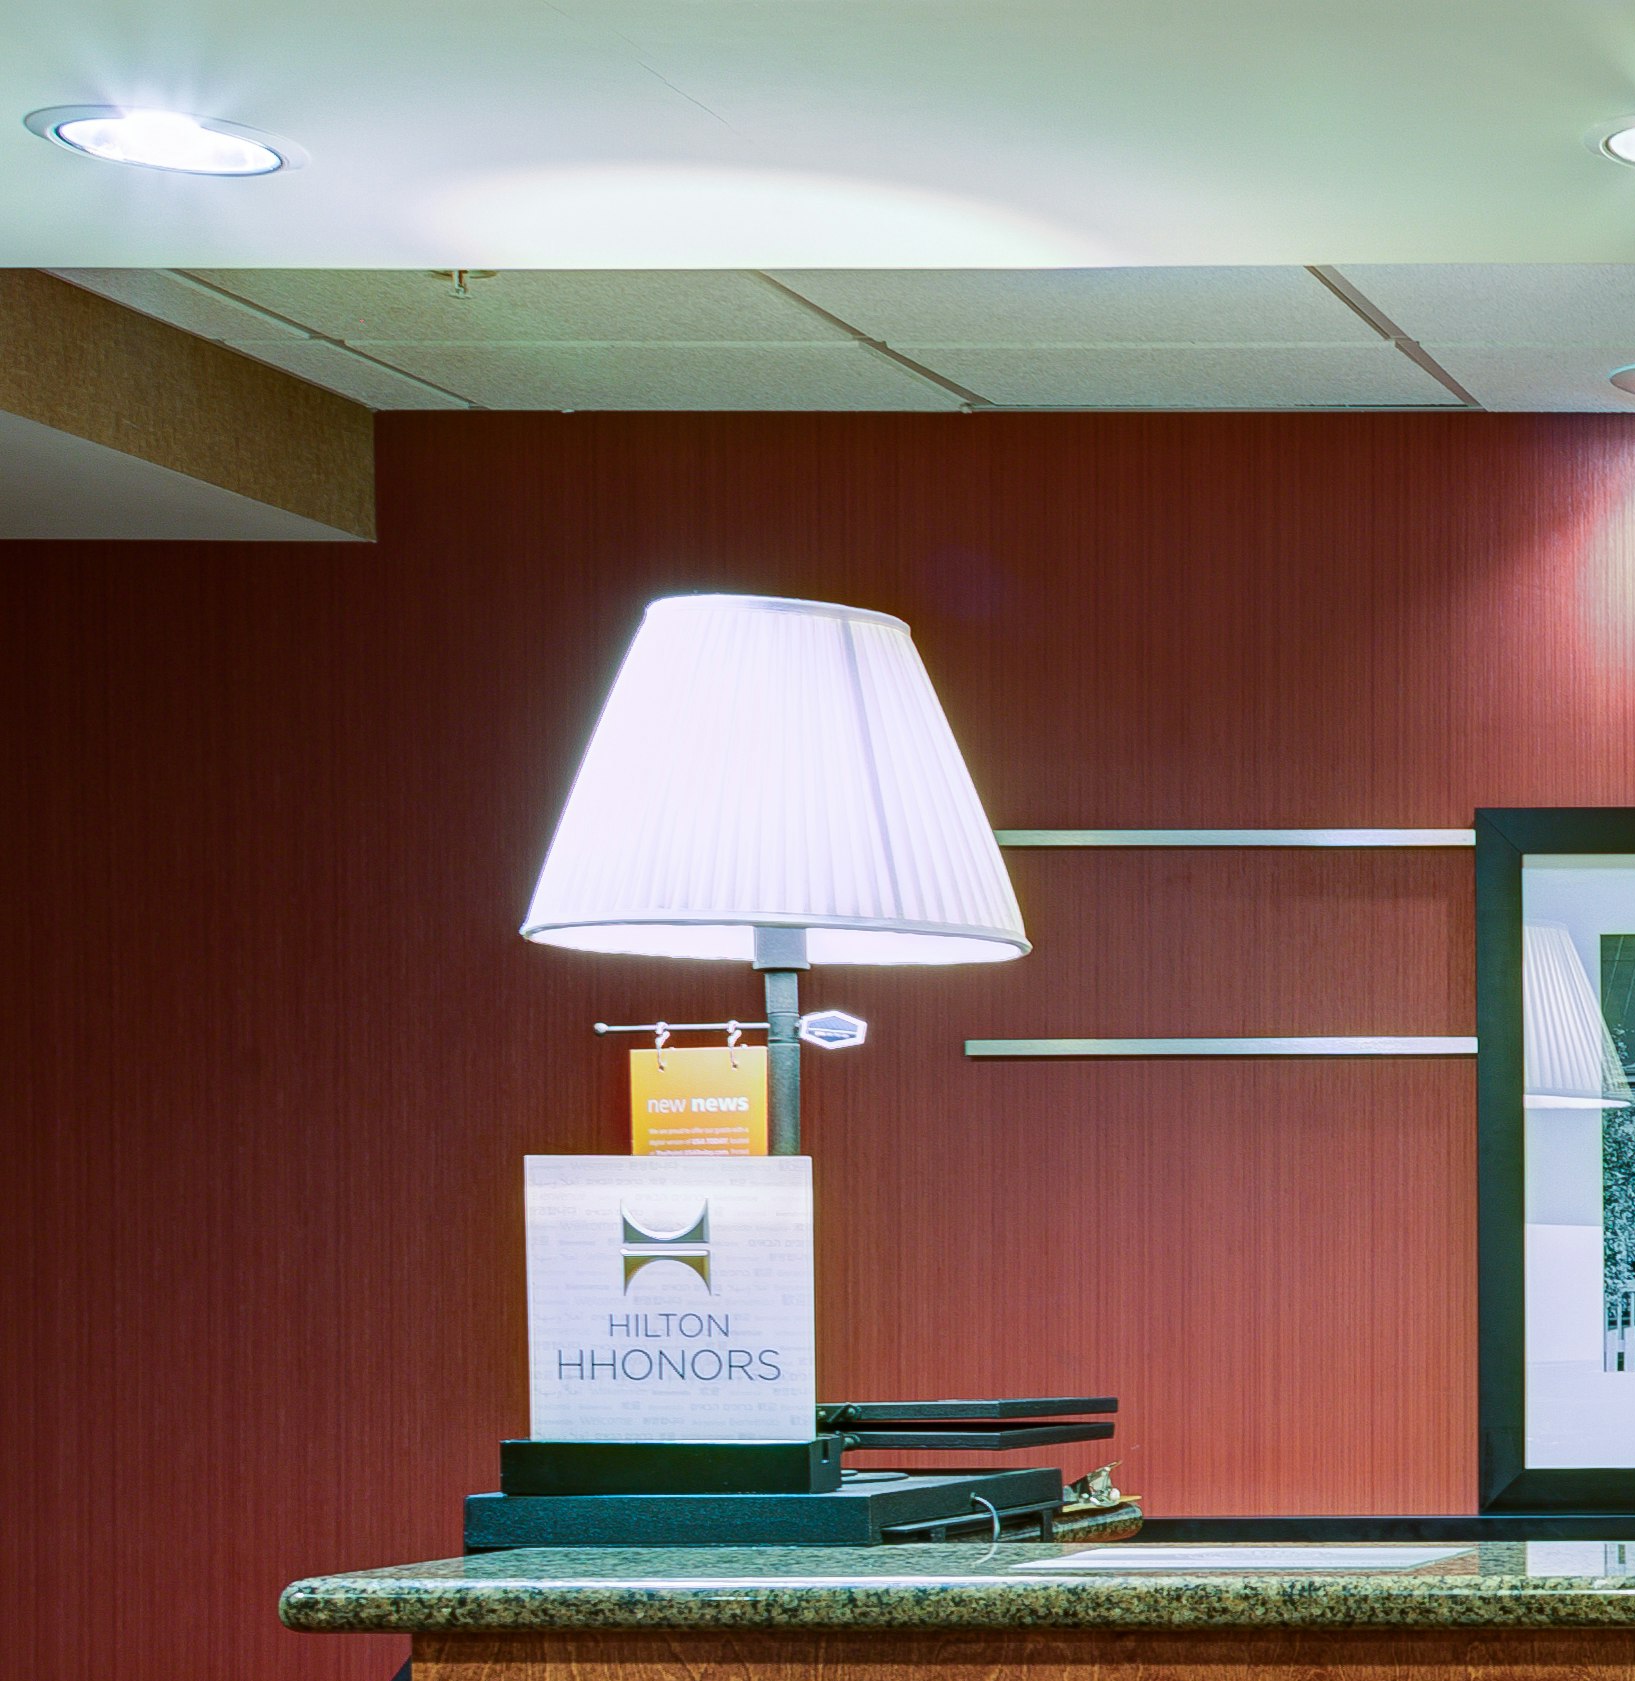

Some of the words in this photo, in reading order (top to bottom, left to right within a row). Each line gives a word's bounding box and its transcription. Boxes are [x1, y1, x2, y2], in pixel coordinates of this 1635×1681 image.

[647, 1098, 687, 1114] new
[690, 1096, 750, 1113] news
[609, 1312, 730, 1339] HILTON
[558, 1348, 782, 1381] HHONORS
